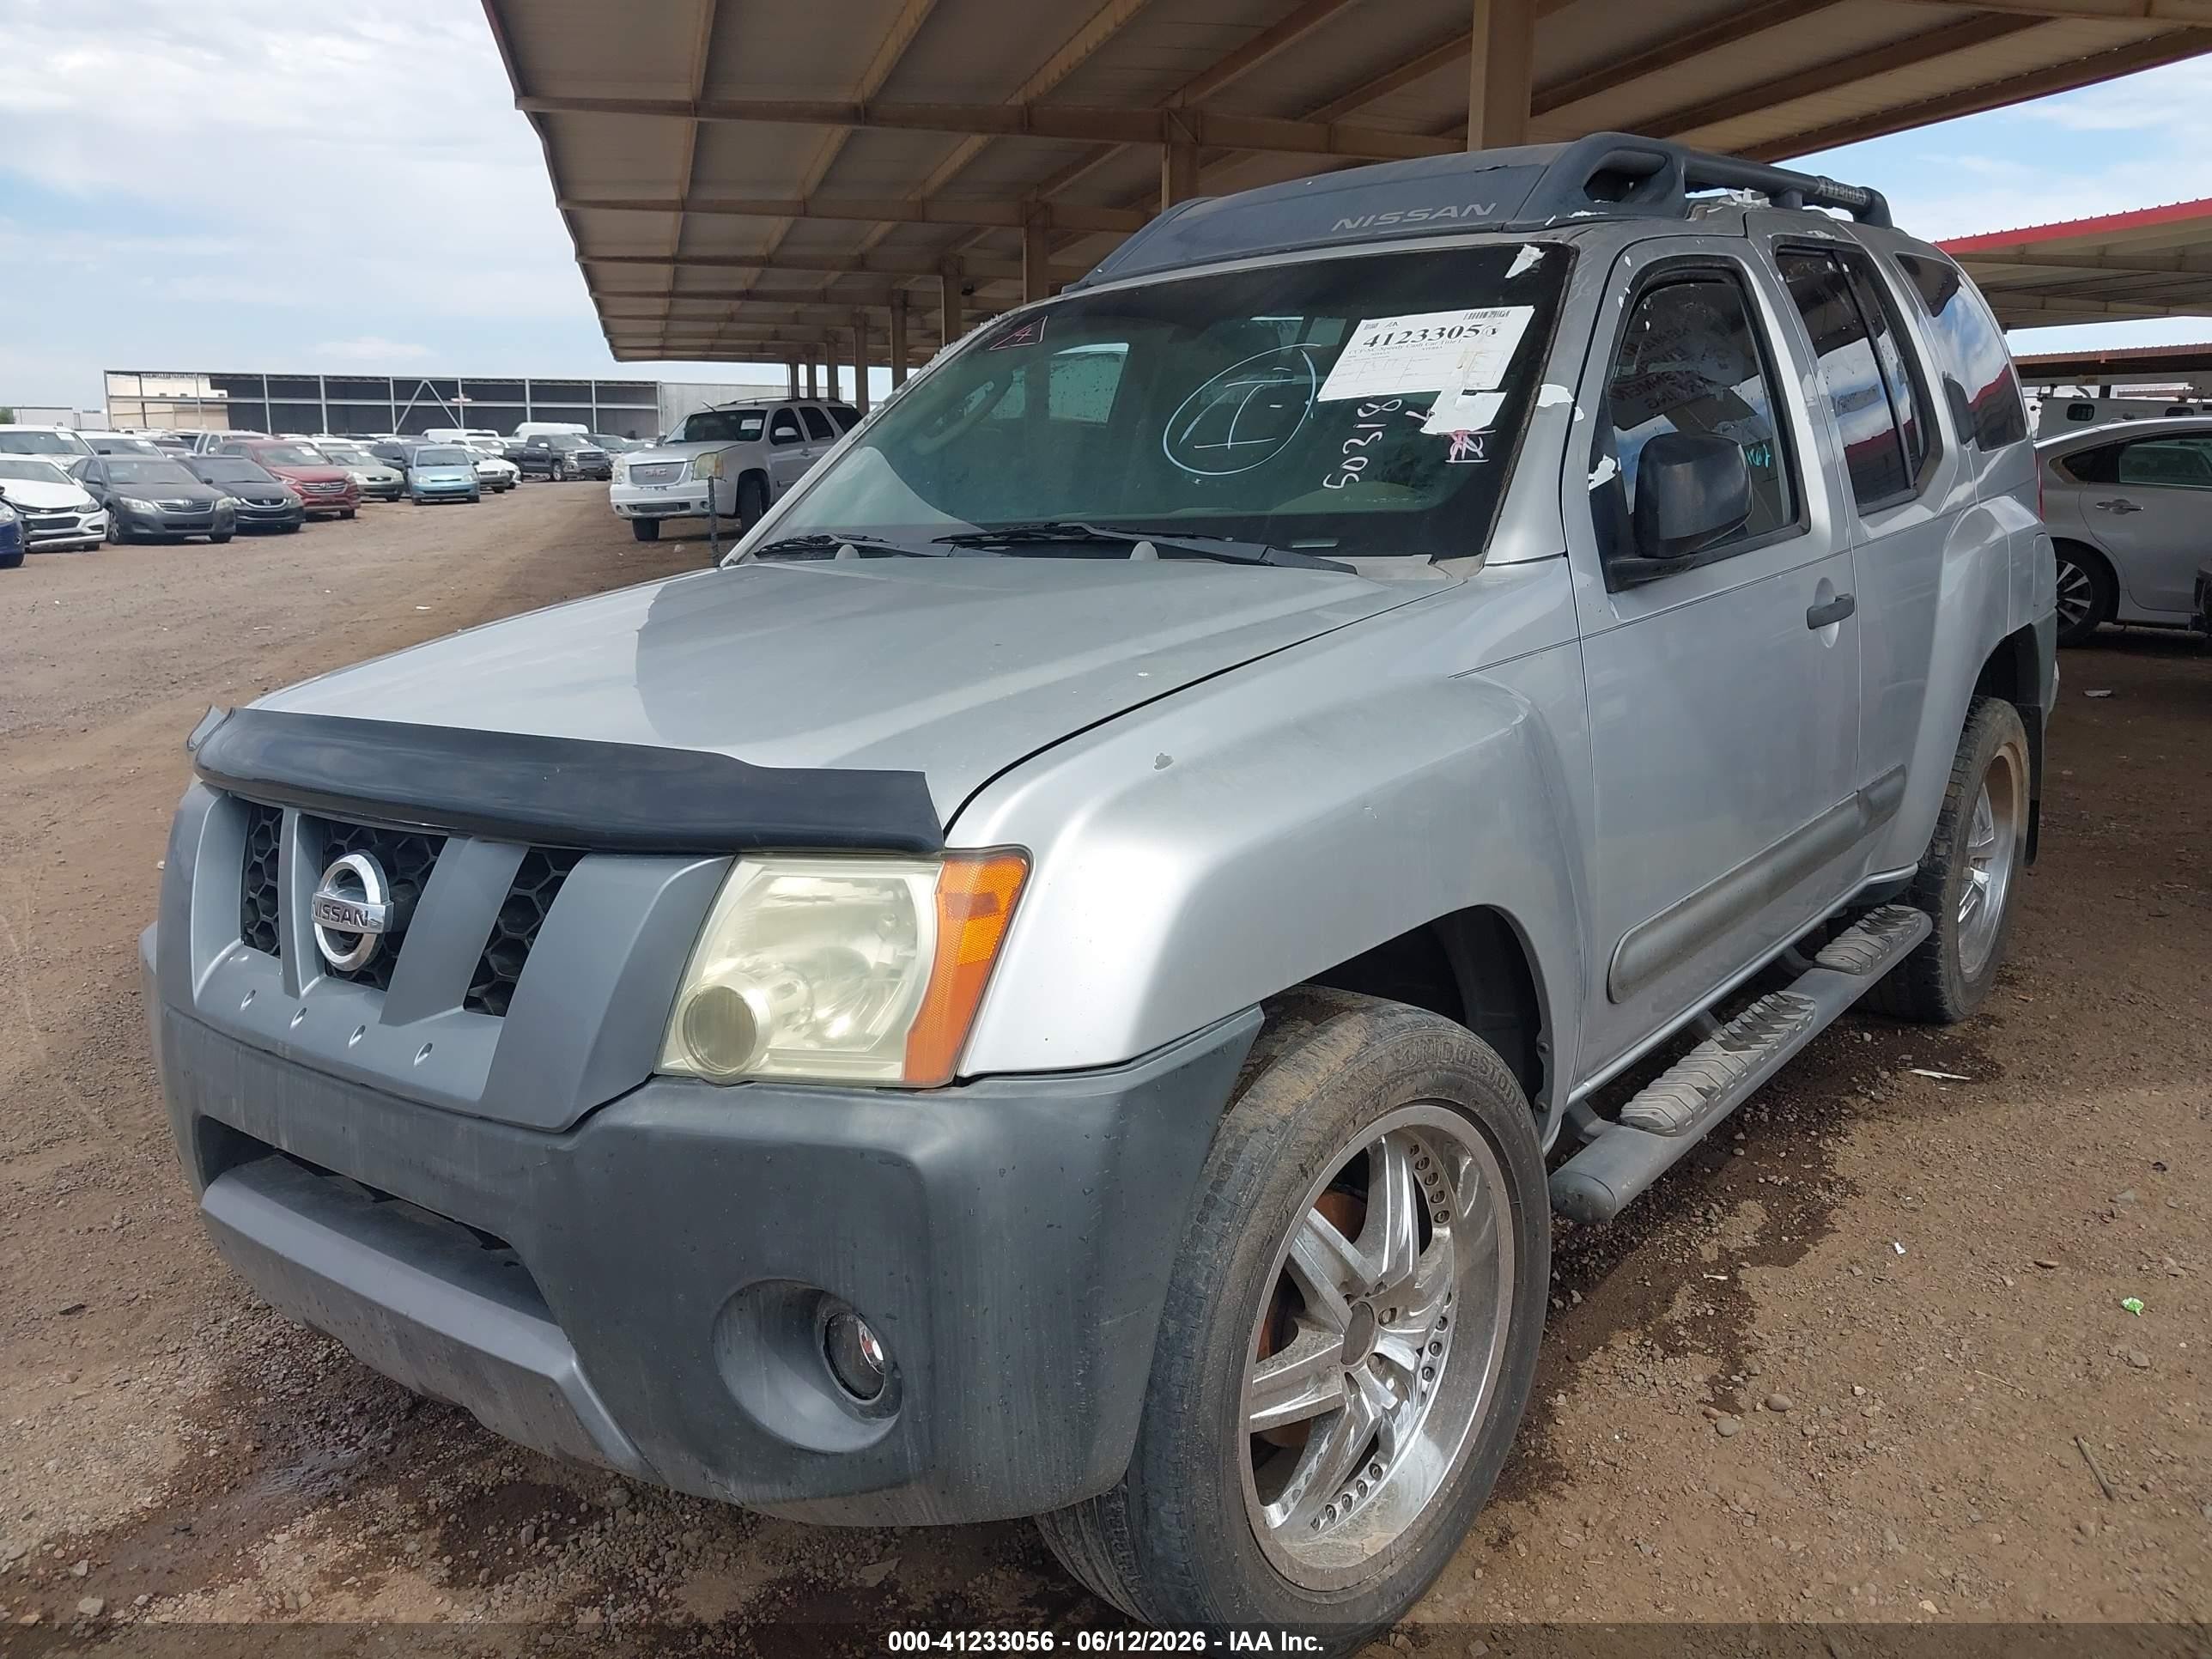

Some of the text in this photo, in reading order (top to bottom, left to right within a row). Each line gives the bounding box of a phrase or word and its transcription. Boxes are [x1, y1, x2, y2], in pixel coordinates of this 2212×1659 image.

[1331, 203, 1498, 232] NISSAN
[1322, 398, 1403, 489] 50318
[312, 901, 369, 928] NISSAN
